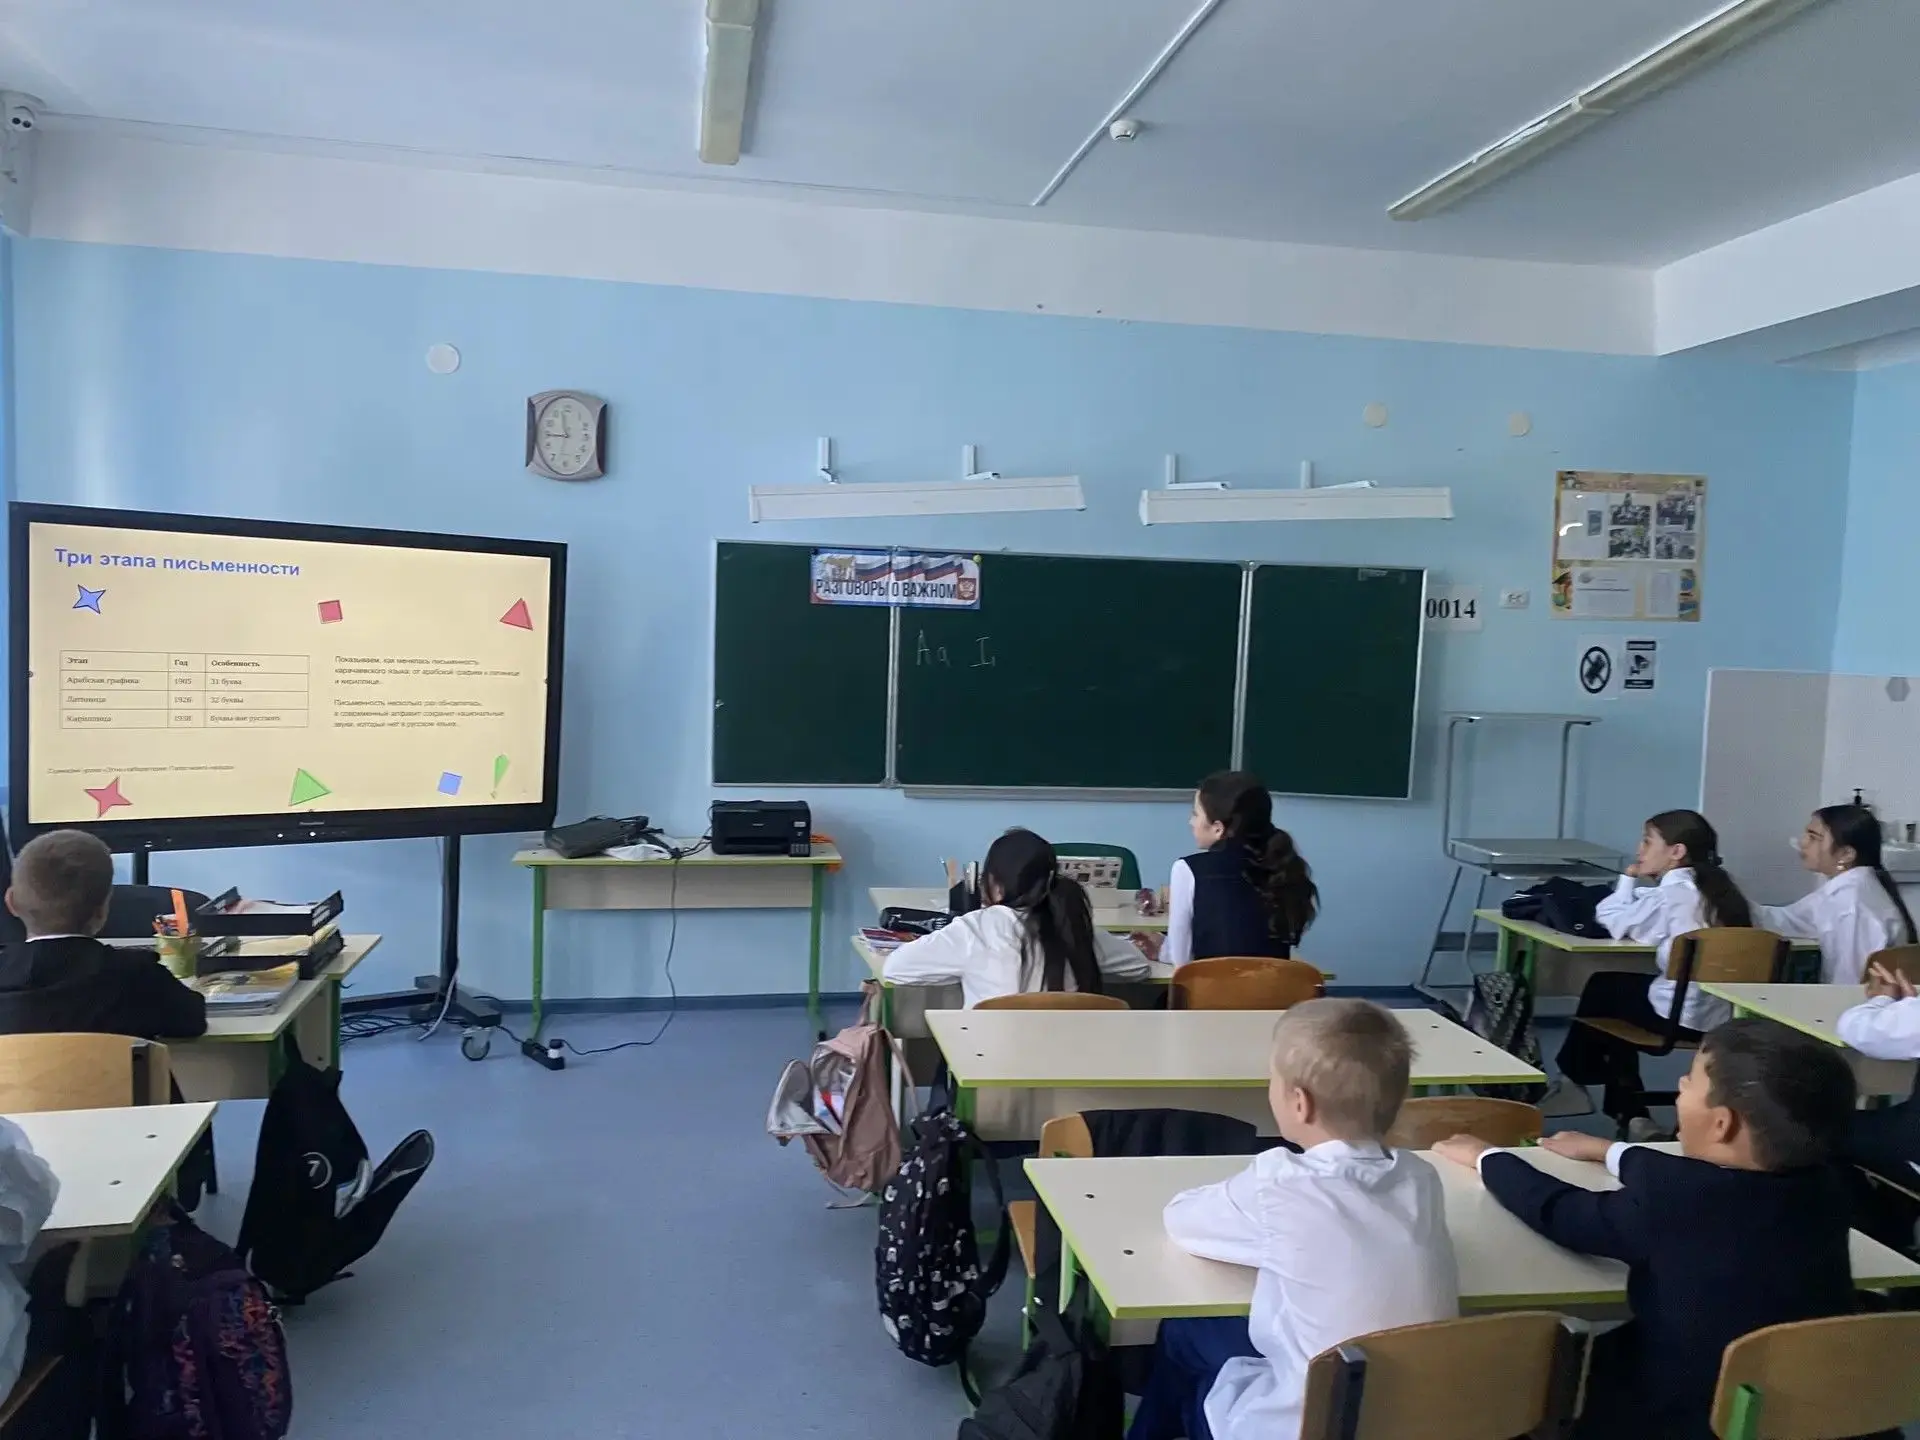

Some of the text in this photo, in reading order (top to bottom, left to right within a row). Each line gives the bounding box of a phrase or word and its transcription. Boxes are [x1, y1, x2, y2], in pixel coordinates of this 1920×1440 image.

[54, 548, 300, 576] Три этапа письменности
[816, 578, 957, 599] РАЗГОВОРЫ О ВАЖНОМ
[1425, 598, 1476, 619] 0014
[174, 659, 188, 667] Год
